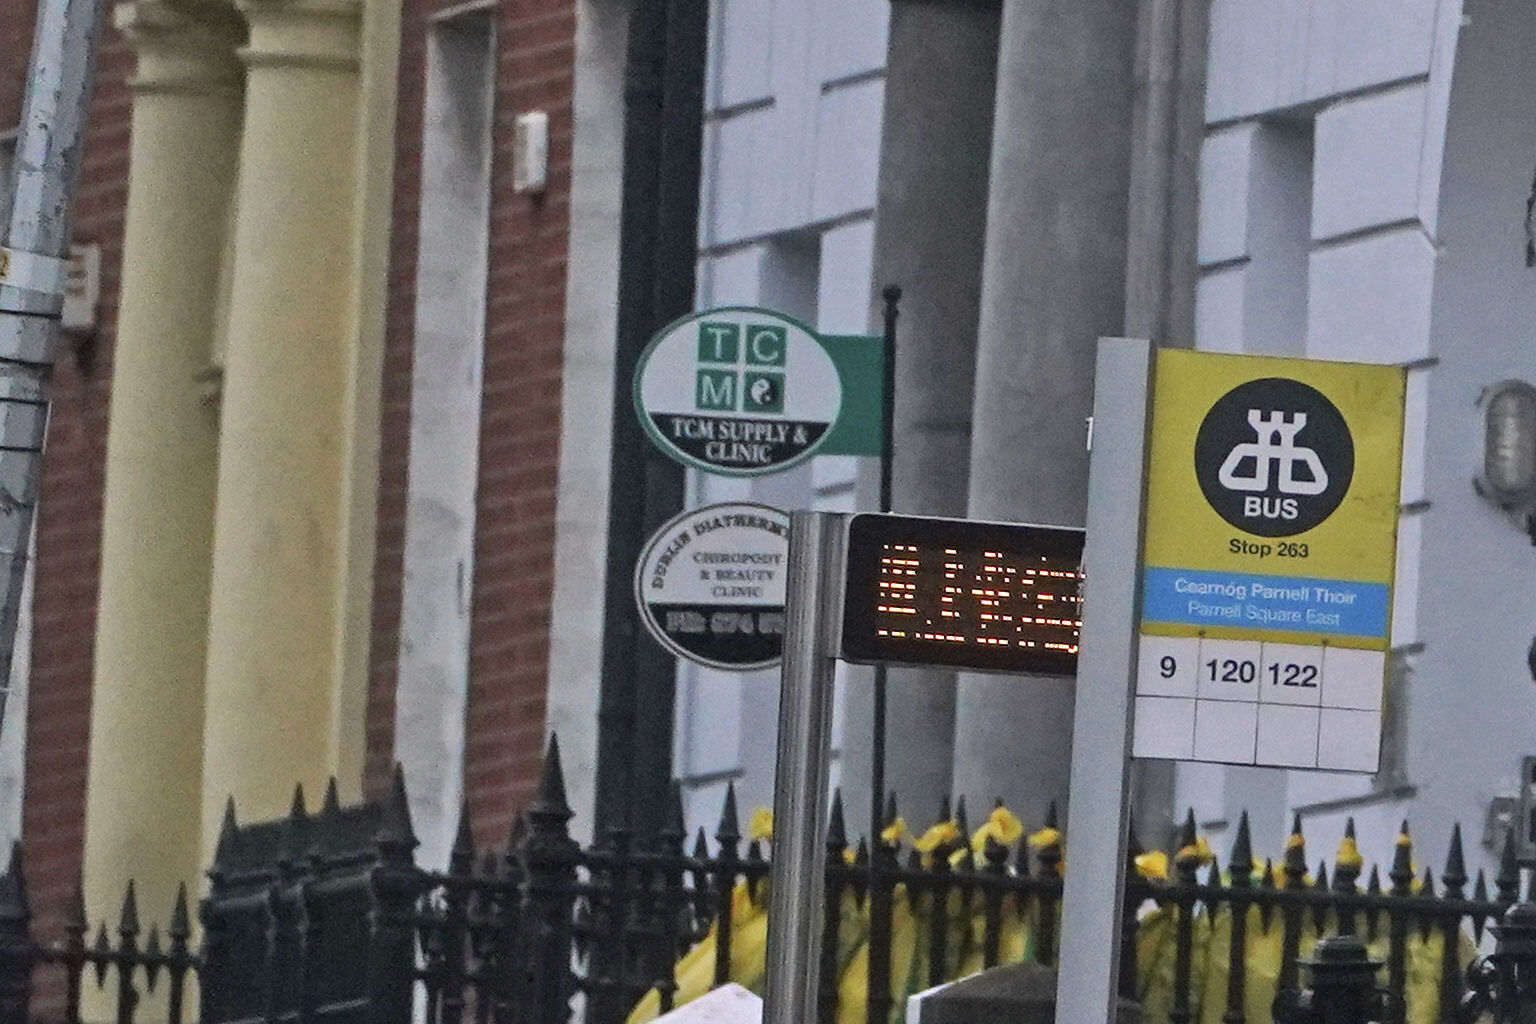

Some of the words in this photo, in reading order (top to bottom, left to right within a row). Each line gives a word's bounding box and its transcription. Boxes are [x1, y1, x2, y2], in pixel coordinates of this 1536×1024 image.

[672, 416, 714, 439] TCM
[718, 420, 790, 443] SUPPLY
[793, 424, 808, 444] &
[704, 441, 773, 464] CLINIC
[1244, 496, 1299, 519] BUS
[1229, 538, 1271, 558] Stop
[1277, 542, 1309, 558] 263
[715, 569, 775, 581] BEAUTY
[1251, 583, 1310, 600] Parnell
[1315, 587, 1358, 604] Thoir
[1187, 600, 1242, 618] Parnell
[1246, 604, 1302, 624] Square
[1306, 608, 1341, 626] East
[1160, 655, 1177, 678] 9
[1206, 658, 1256, 684] 120
[1268, 662, 1319, 688] 122
